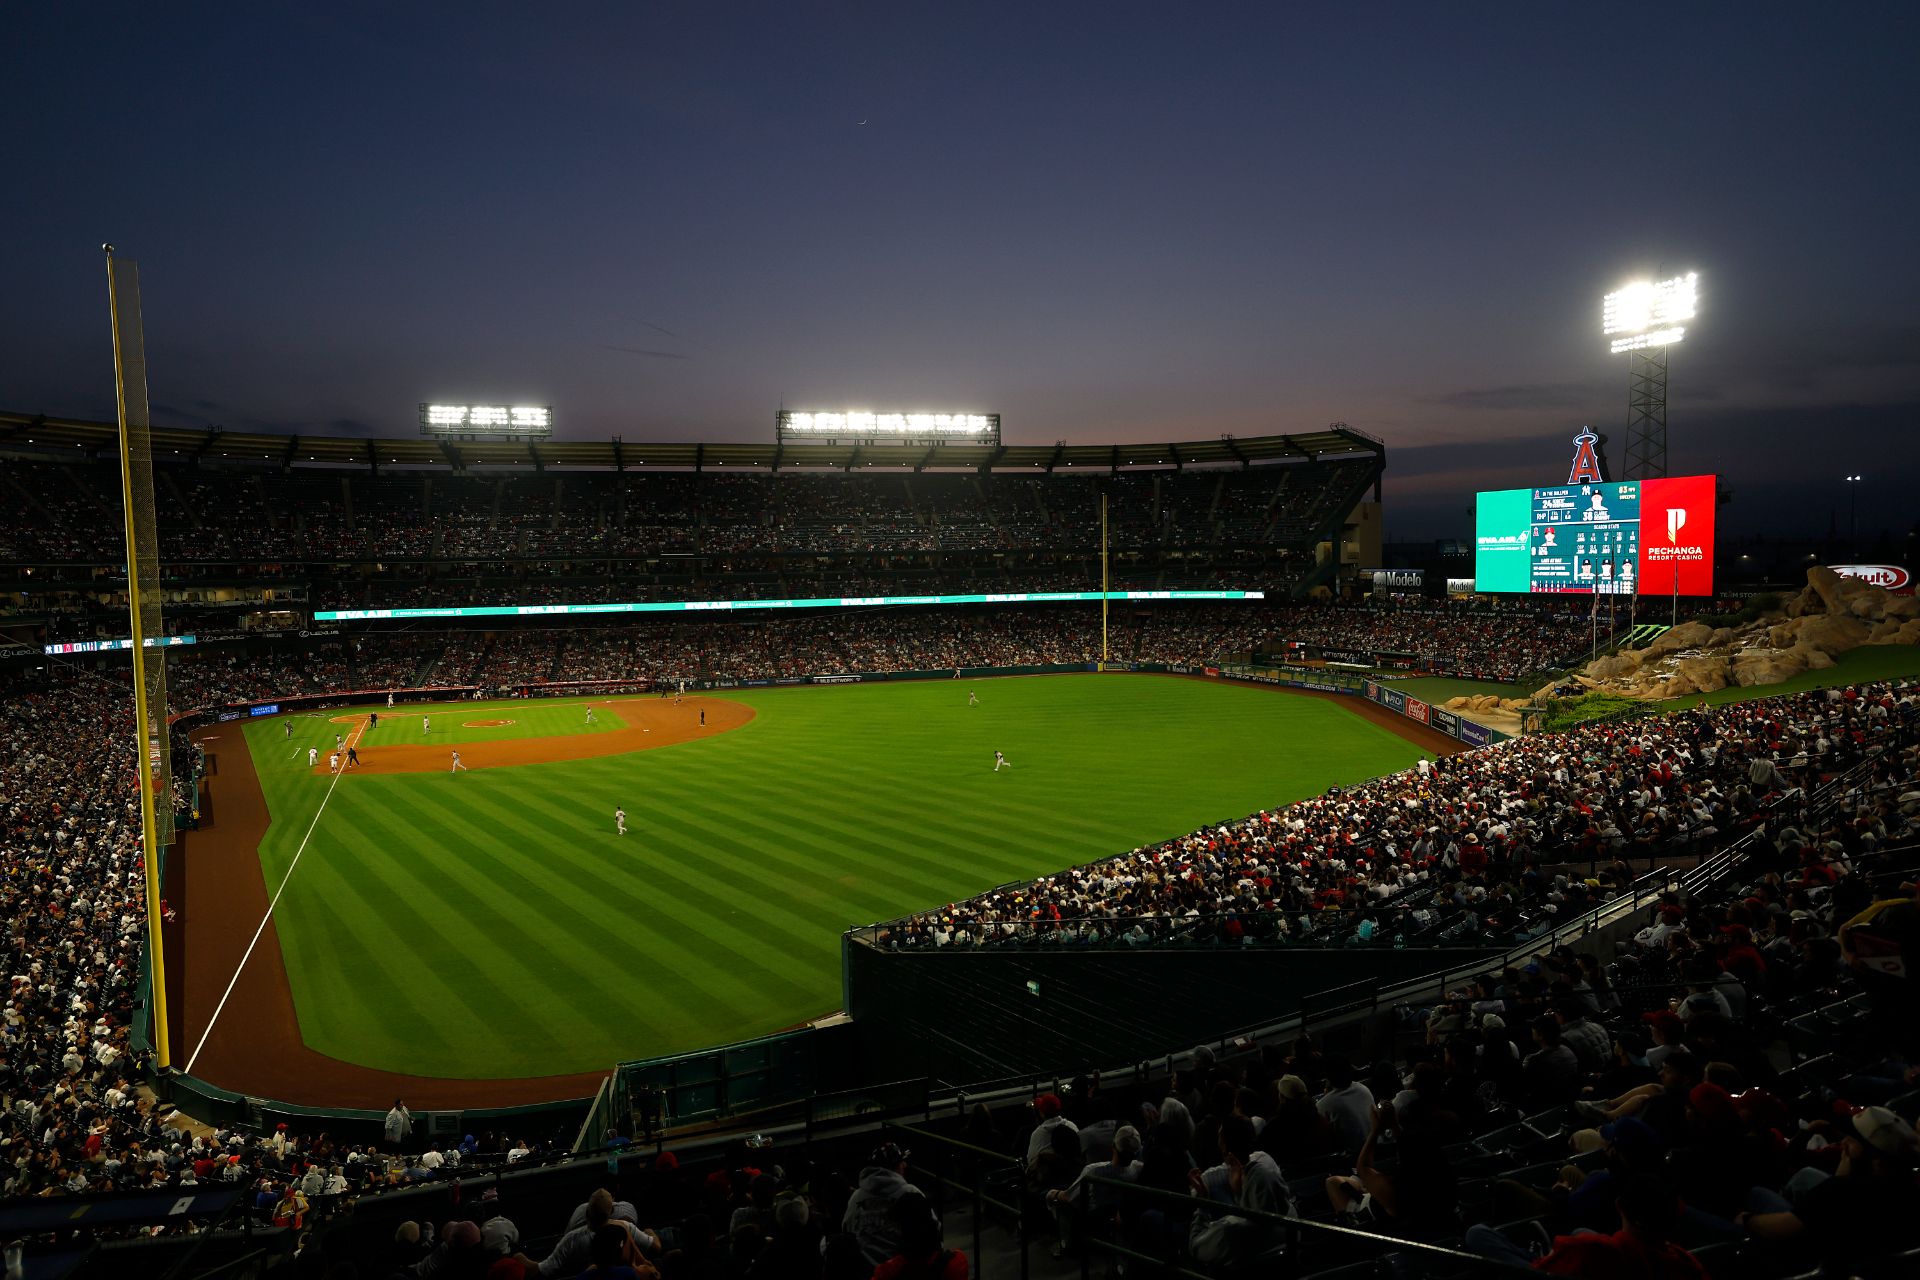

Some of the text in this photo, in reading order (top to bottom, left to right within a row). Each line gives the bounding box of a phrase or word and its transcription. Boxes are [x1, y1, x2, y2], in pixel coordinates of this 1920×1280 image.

[1648, 546, 1703, 555] PECHANGA
[1387, 571, 1423, 587] Modelo
[324, 1179, 336, 1191] 27
